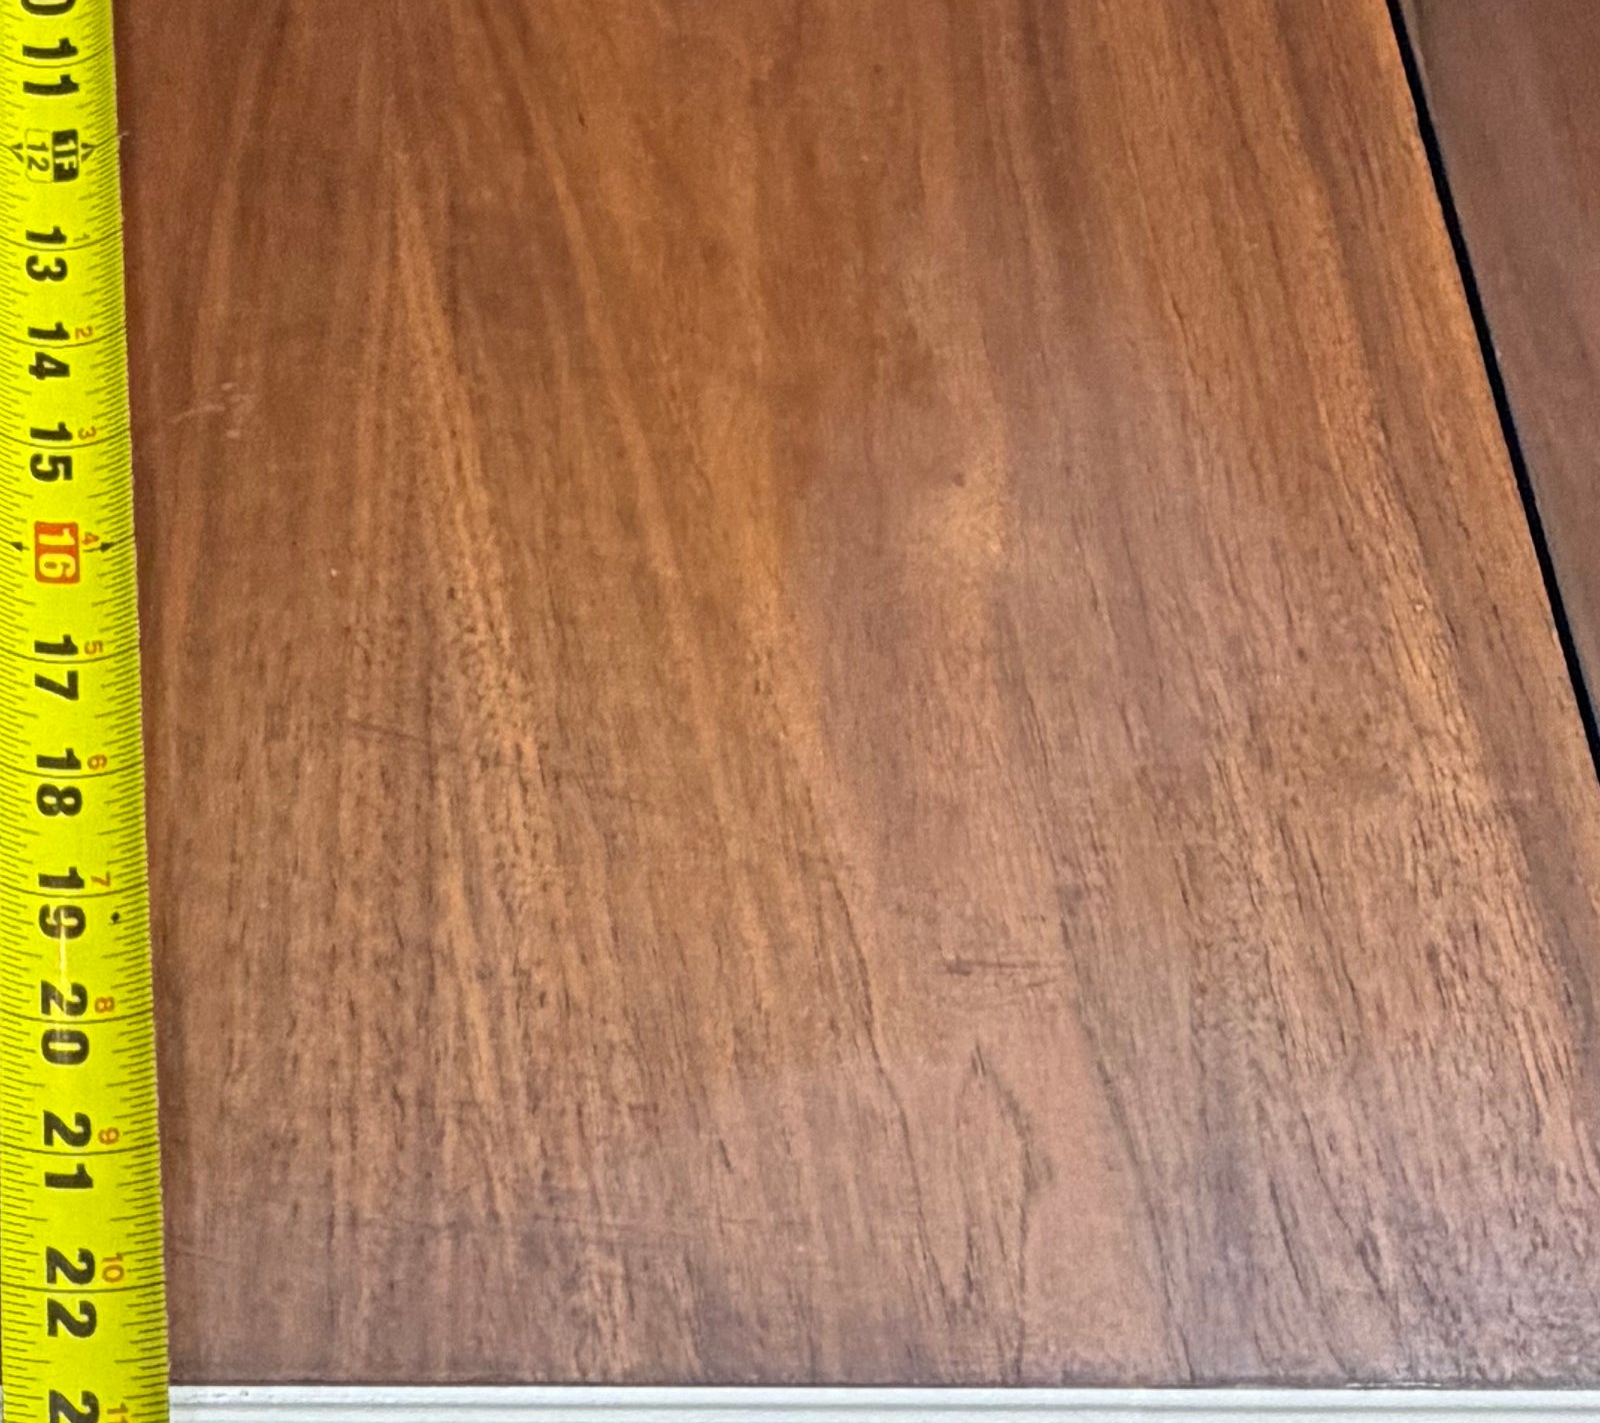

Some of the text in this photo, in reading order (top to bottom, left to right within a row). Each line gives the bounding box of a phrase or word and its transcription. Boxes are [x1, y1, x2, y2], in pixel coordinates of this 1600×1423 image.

[22, 37, 79, 95] 11
[26, 141, 50, 172] 12
[53, 139, 78, 170] 1F
[26, 225, 68, 282] 13
[28, 321, 70, 380] 14
[74, 325, 94, 340] 2
[30, 421, 73, 482] 15
[77, 425, 97, 441] 3
[38, 527, 77, 579] 16
[82, 531, 100, 546] 4
[34, 633, 79, 701] 17
[84, 640, 104, 655] 5
[36, 747, 82, 817] 18
[87, 754, 108, 771] 6
[90, 871, 111, 888] 7
[38, 866, 86, 940] 19
[40, 979, 90, 1066] 20
[94, 996, 115, 1014] 8
[43, 1109, 94, 1189] 21
[98, 1127, 120, 1145] 9
[101, 1251, 125, 1283] 10
[46, 1245, 97, 1338] 22
